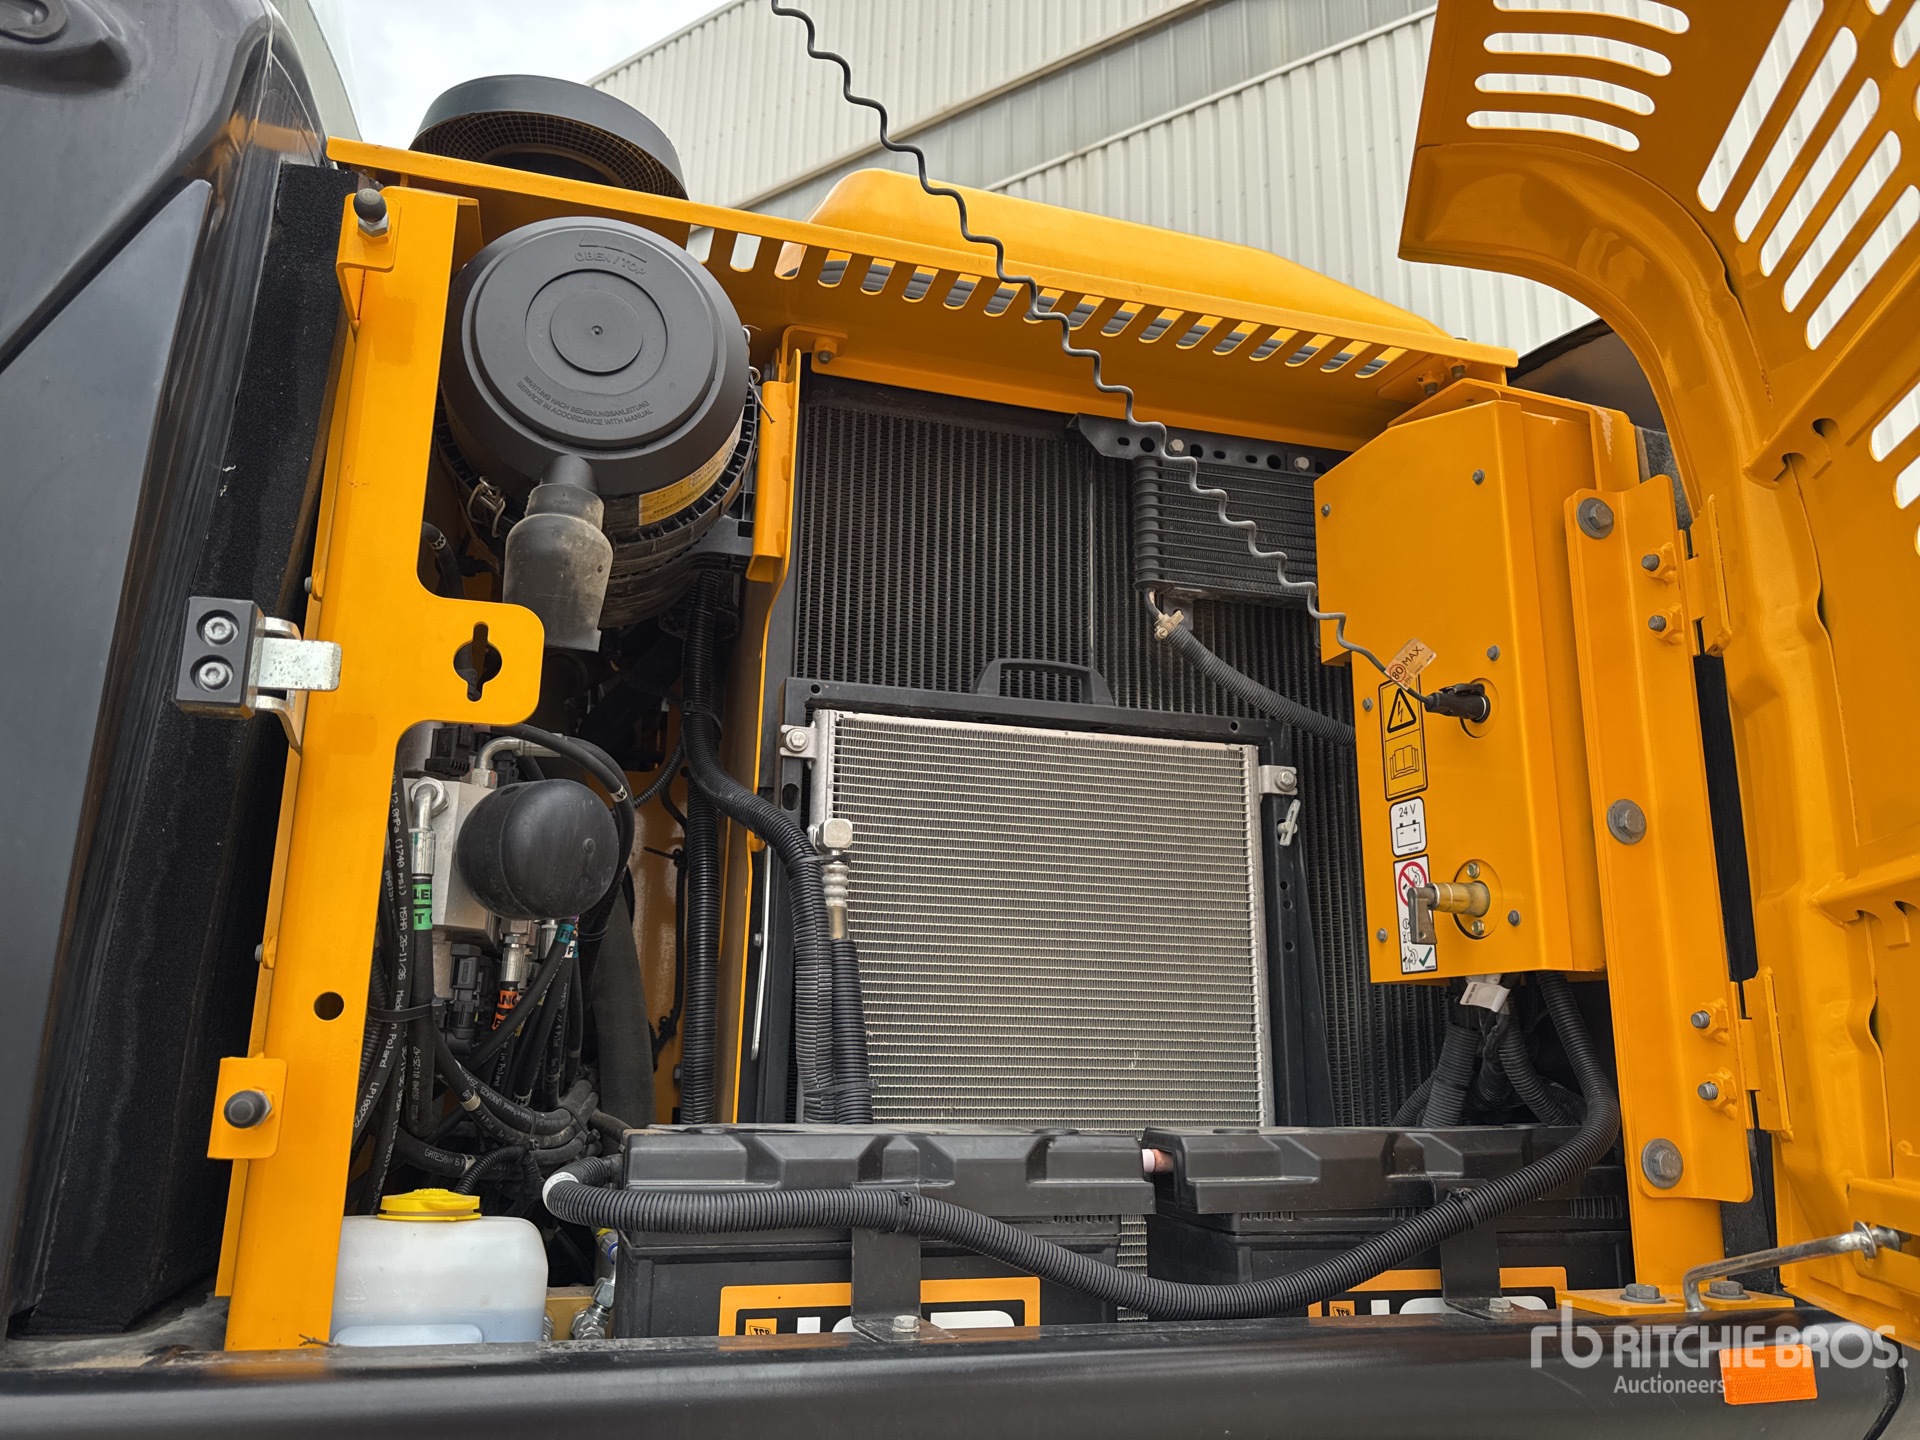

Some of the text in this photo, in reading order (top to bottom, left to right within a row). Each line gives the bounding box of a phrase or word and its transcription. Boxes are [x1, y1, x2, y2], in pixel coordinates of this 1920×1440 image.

[575, 251, 612, 263] OBEN
[621, 257, 646, 275] TOP
[516, 381, 654, 426] SERVICE IN ACCORDANCE WITH MANUAL
[523, 375, 650, 418] WARTUNG NACH BEDIENUNGSANLEITUNG
[1392, 666, 1404, 680] 80
[1399, 804, 1417, 818] 24 V
[413, 888, 433, 901] LE
[378, 1033, 397, 1068] Poland
